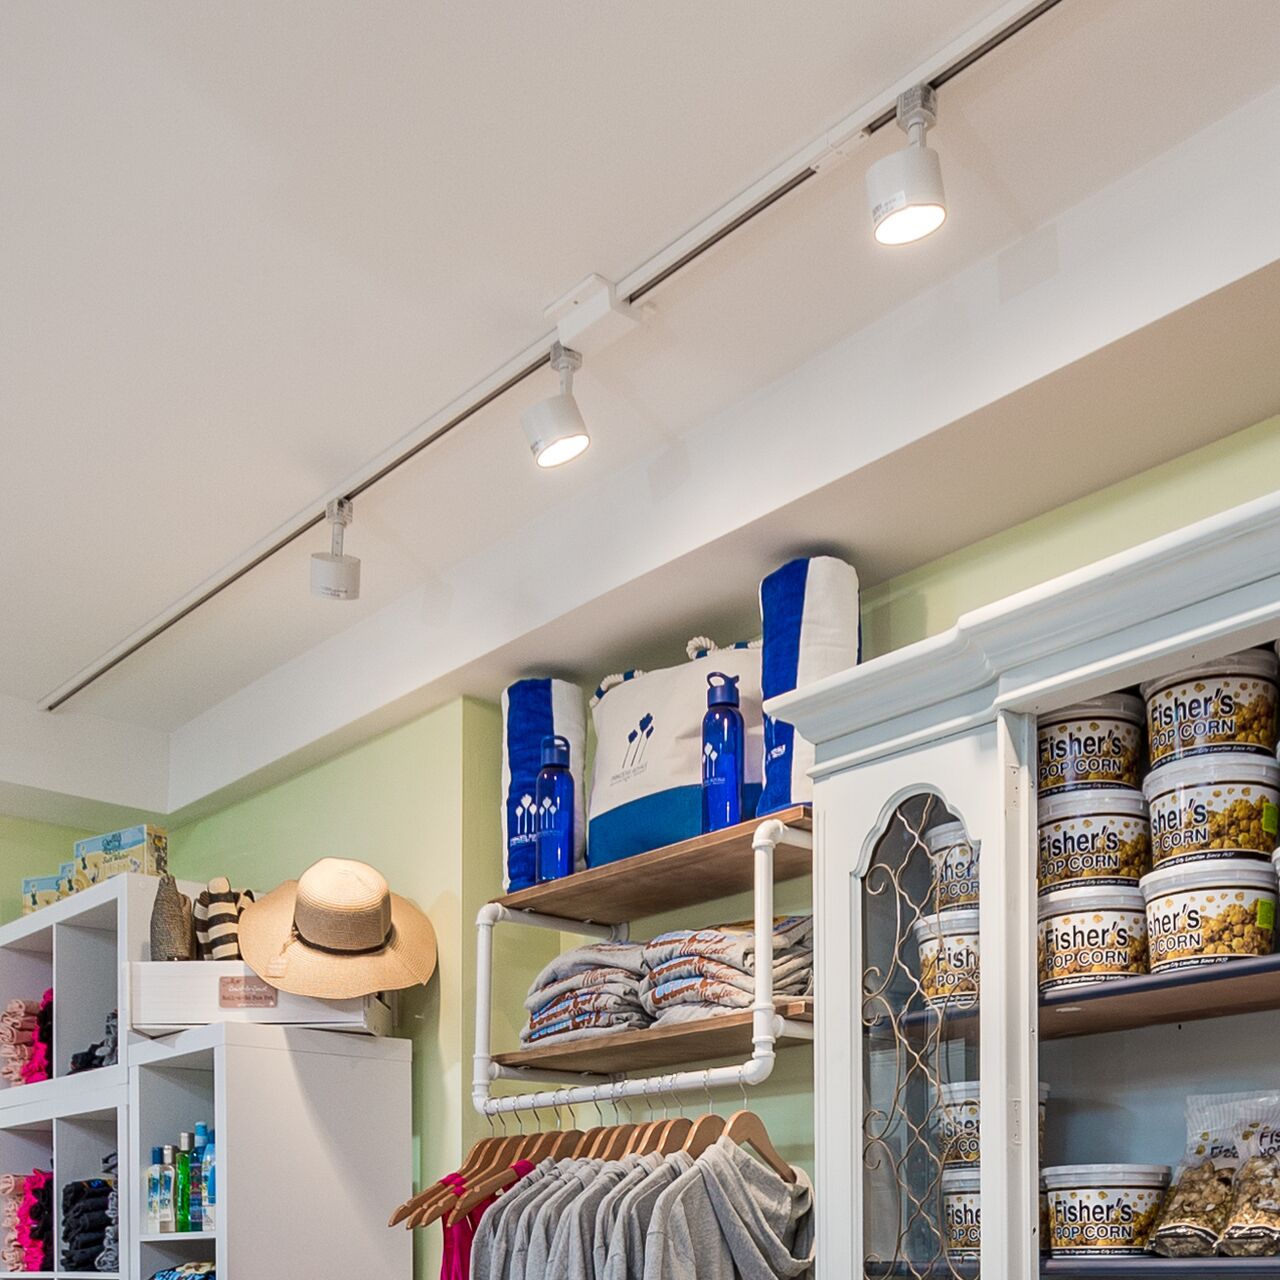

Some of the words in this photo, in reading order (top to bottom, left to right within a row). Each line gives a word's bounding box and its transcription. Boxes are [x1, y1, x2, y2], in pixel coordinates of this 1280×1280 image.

[1150, 687, 1234, 734] Fisher's
[1181, 719, 1234, 739] CORN
[1038, 729, 1122, 764] Fisher's
[1040, 761, 1070, 779] POP
[1075, 758, 1121, 773] CORN
[1152, 798, 1207, 837] sher's
[1039, 825, 1119, 859] Fisher's
[1163, 827, 1208, 850] CORN
[1069, 854, 1119, 871] CORN
[1148, 903, 1201, 939] sher's
[1044, 921, 1129, 955] Fisher's
[1158, 933, 1201, 955] CORN
[1046, 953, 1073, 972] POP
[1079, 949, 1129, 967] CORN
[1054, 1197, 1133, 1224] Fisher's
[1056, 1225, 1080, 1240] POP
[1084, 1225, 1133, 1240] CORN
